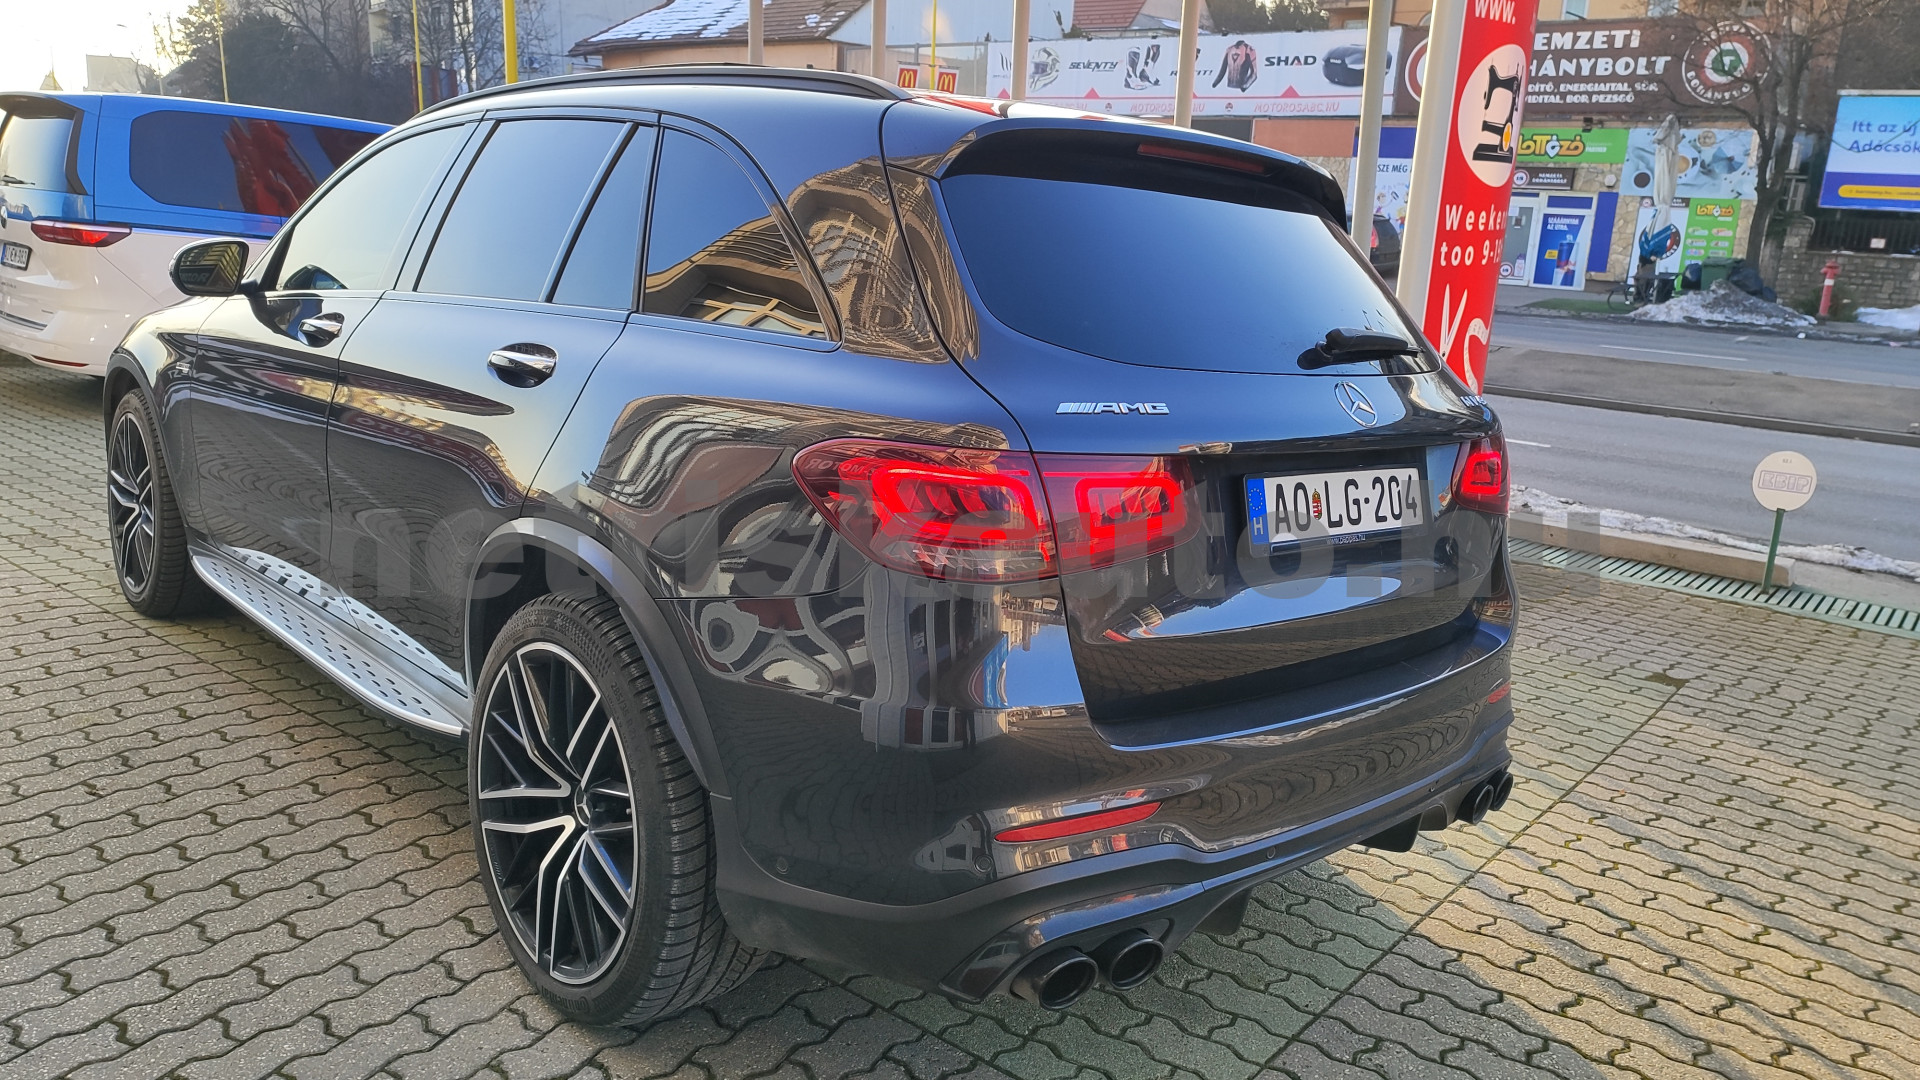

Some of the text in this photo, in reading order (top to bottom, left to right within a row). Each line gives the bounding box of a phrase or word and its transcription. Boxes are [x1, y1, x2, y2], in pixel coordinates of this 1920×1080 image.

[1533, 30, 1641, 50] EMZETI
[1069, 60, 1119, 72] SEVENTY
[1265, 55, 1317, 67] SHAD
[1852, 121, 1872, 133] Itt
[1878, 124, 1897, 133] az
[1391, 164, 1408, 173] MÉG
[1440, 241, 1474, 266] too
[1094, 402, 1170, 415] AMG
[1253, 517, 1264, 535] H
[1275, 482, 1312, 534] AO
